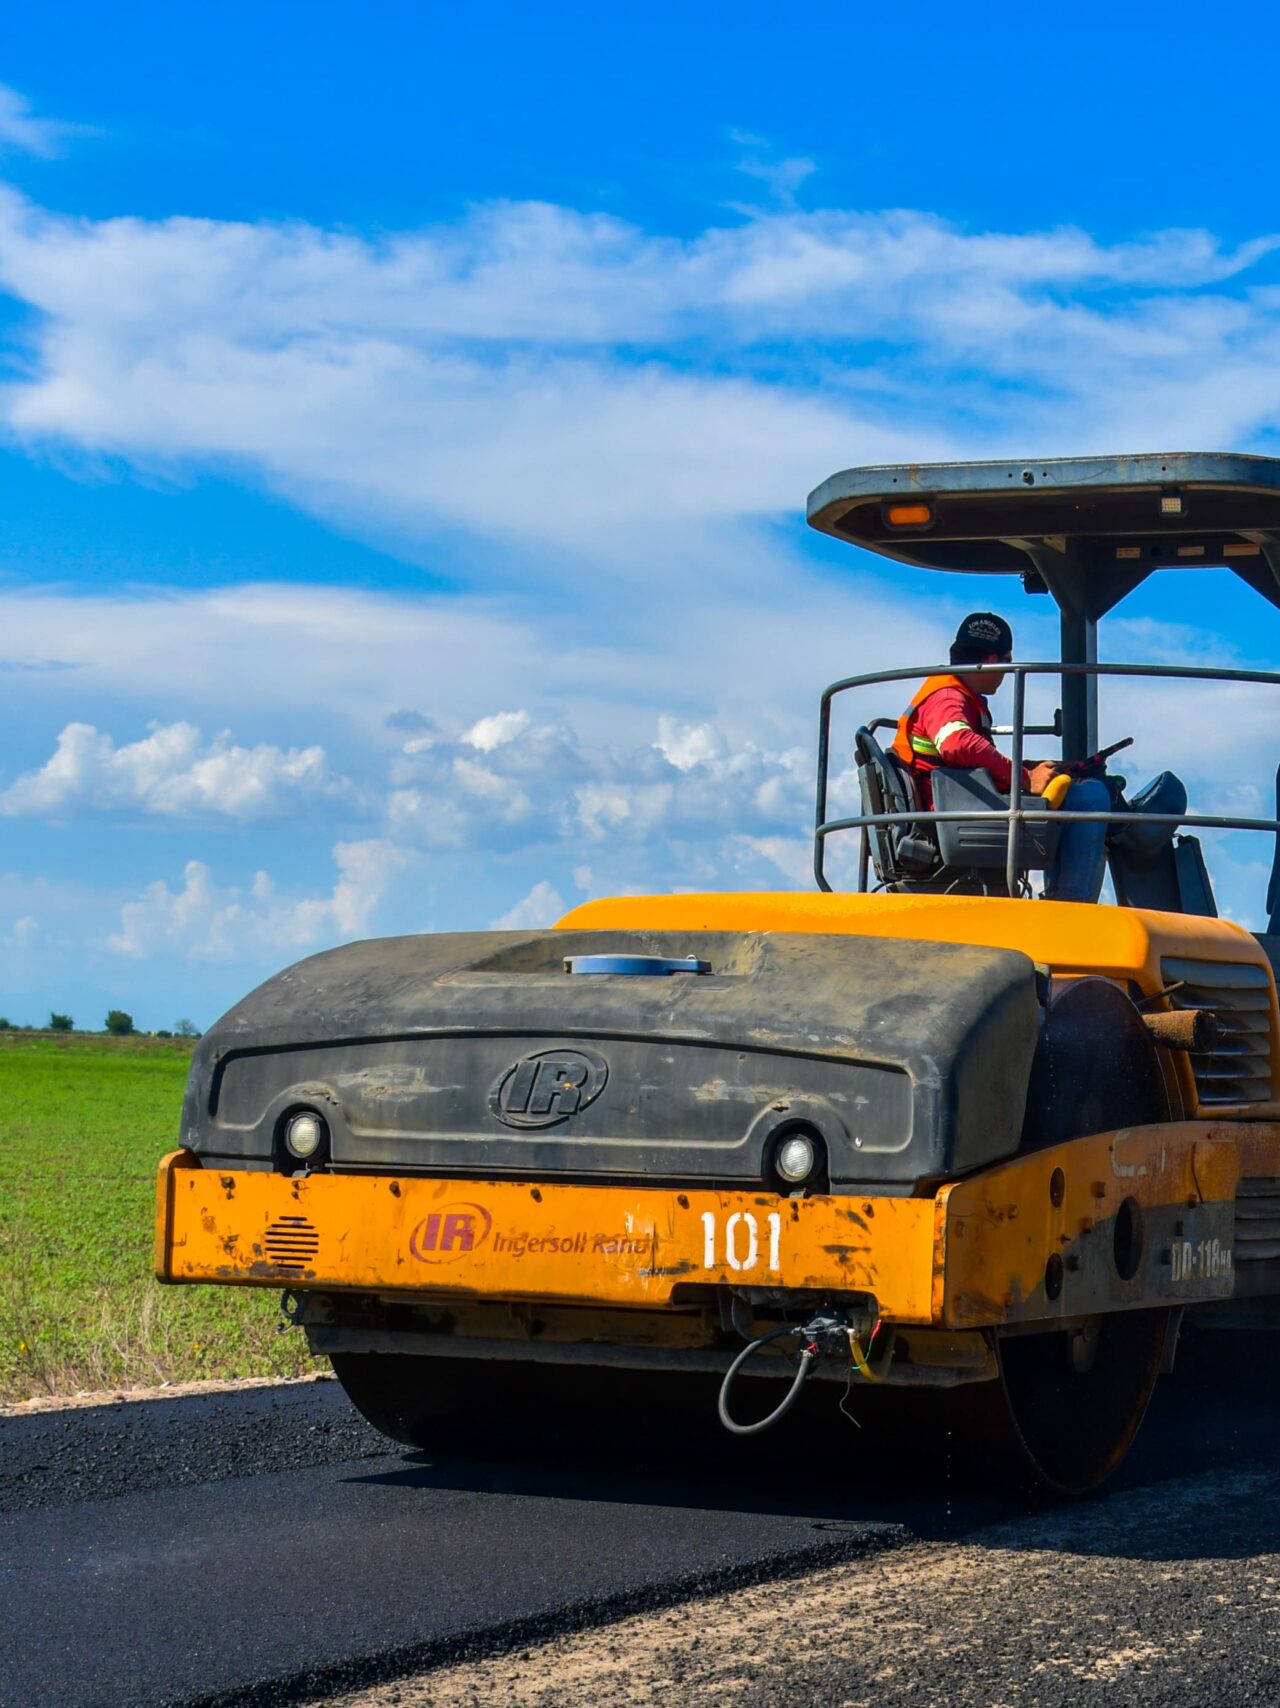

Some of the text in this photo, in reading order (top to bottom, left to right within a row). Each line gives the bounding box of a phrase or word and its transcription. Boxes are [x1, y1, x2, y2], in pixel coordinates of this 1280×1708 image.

[505, 1060, 588, 1115] IR
[421, 1213, 475, 1251] IR
[493, 1231, 588, 1258] Ingersoll
[701, 1211, 780, 1271] 101
